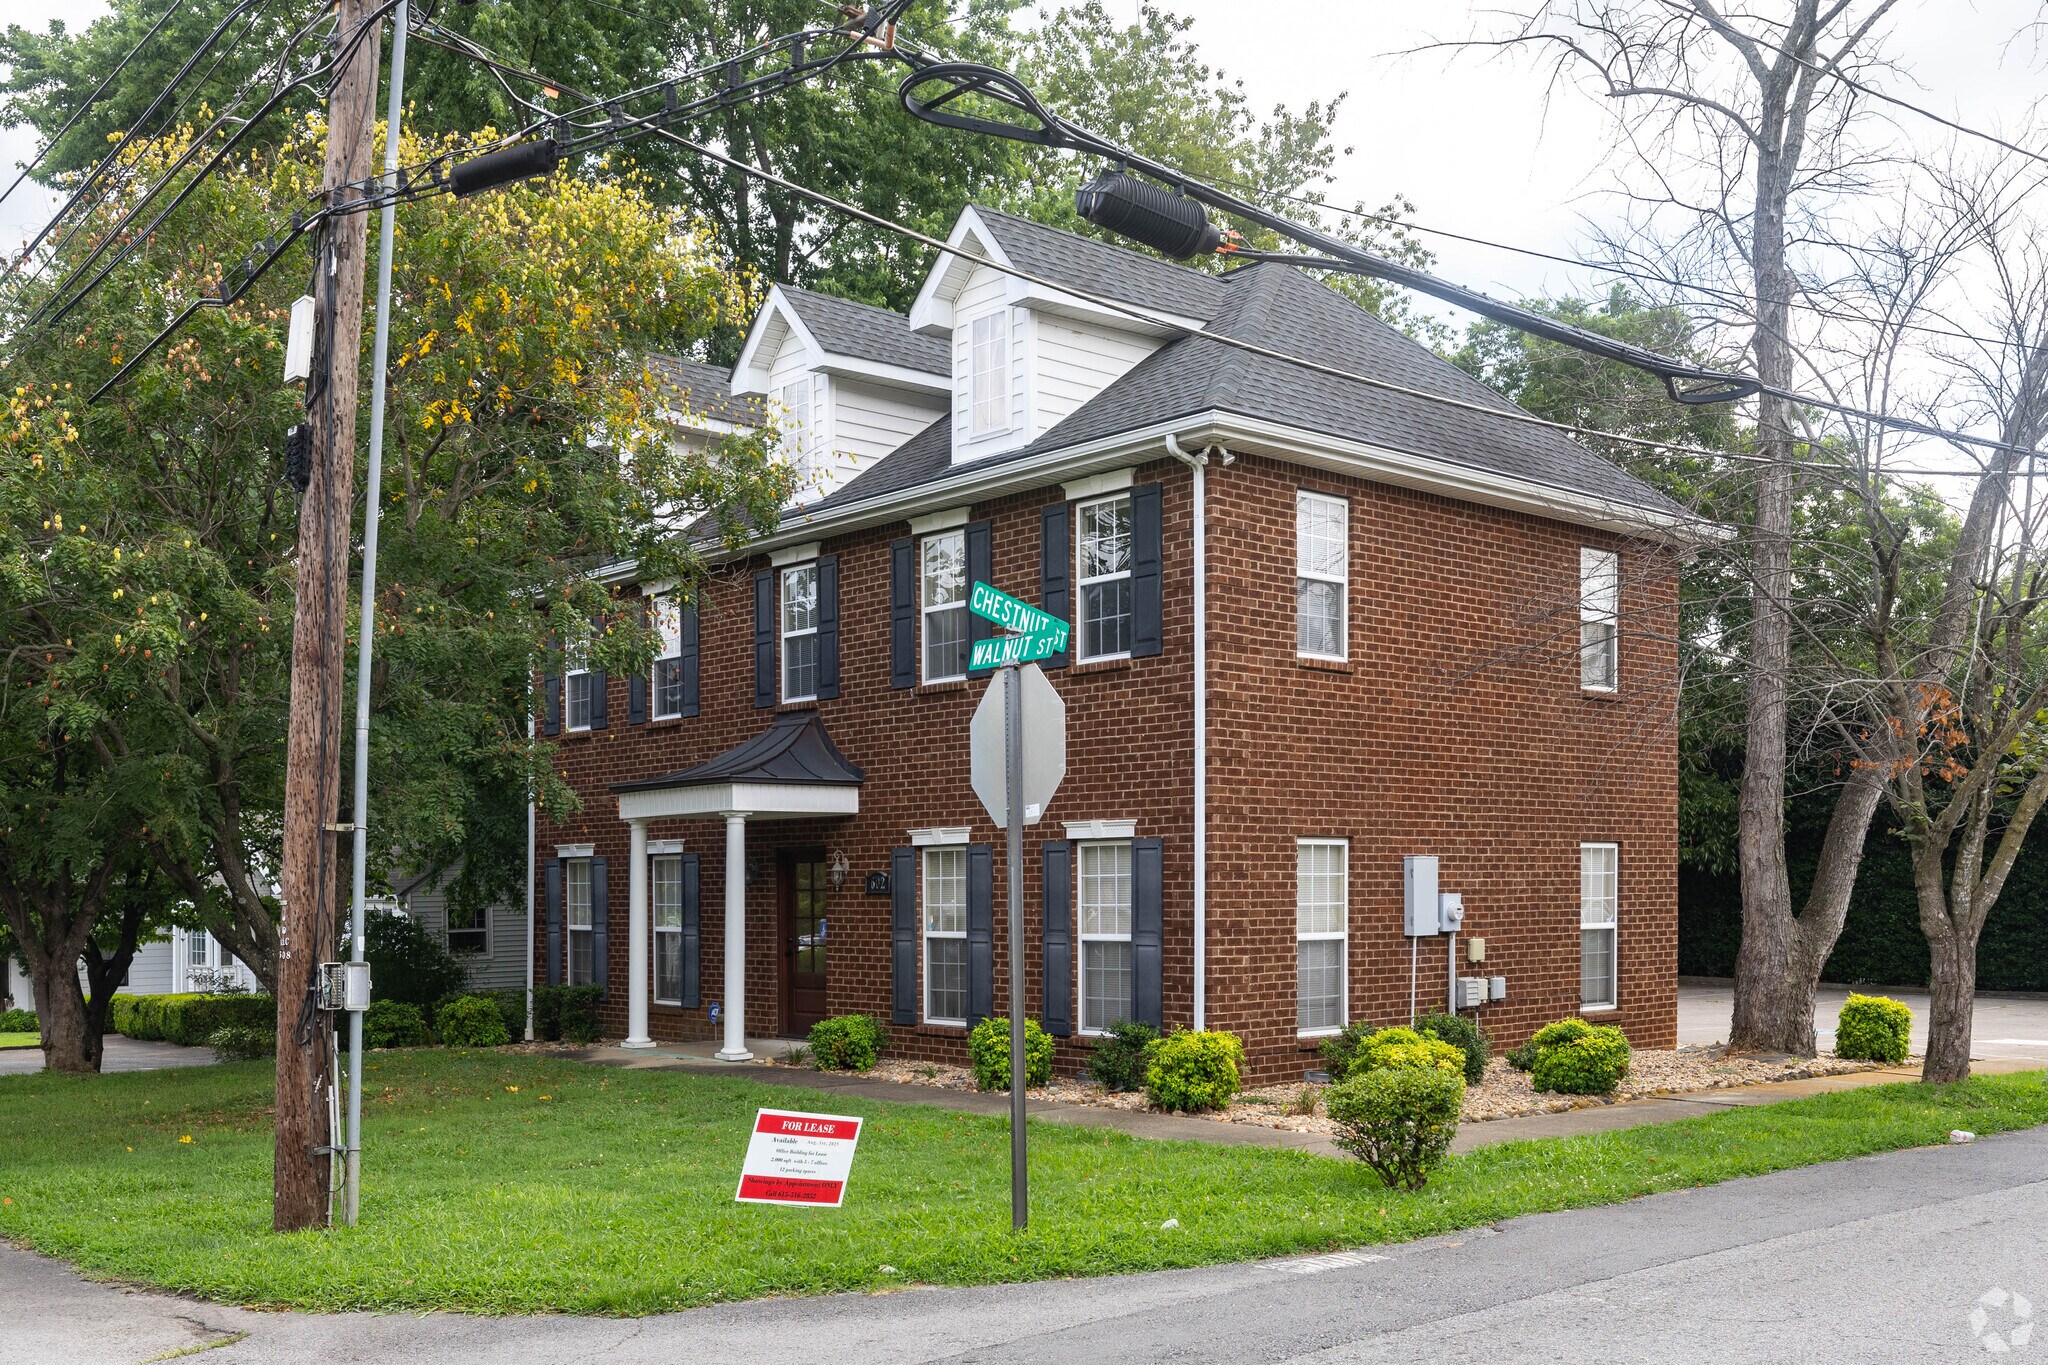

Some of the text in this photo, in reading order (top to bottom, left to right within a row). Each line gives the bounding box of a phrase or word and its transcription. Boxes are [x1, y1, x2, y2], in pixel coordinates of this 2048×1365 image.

[973, 586, 1050, 633] CHESTNUT
[972, 636, 1054, 666] WALNUT ST
[781, 1120, 836, 1134] FOR LEASE
[747, 1177, 838, 1189] Showings by Appointment ONLY
